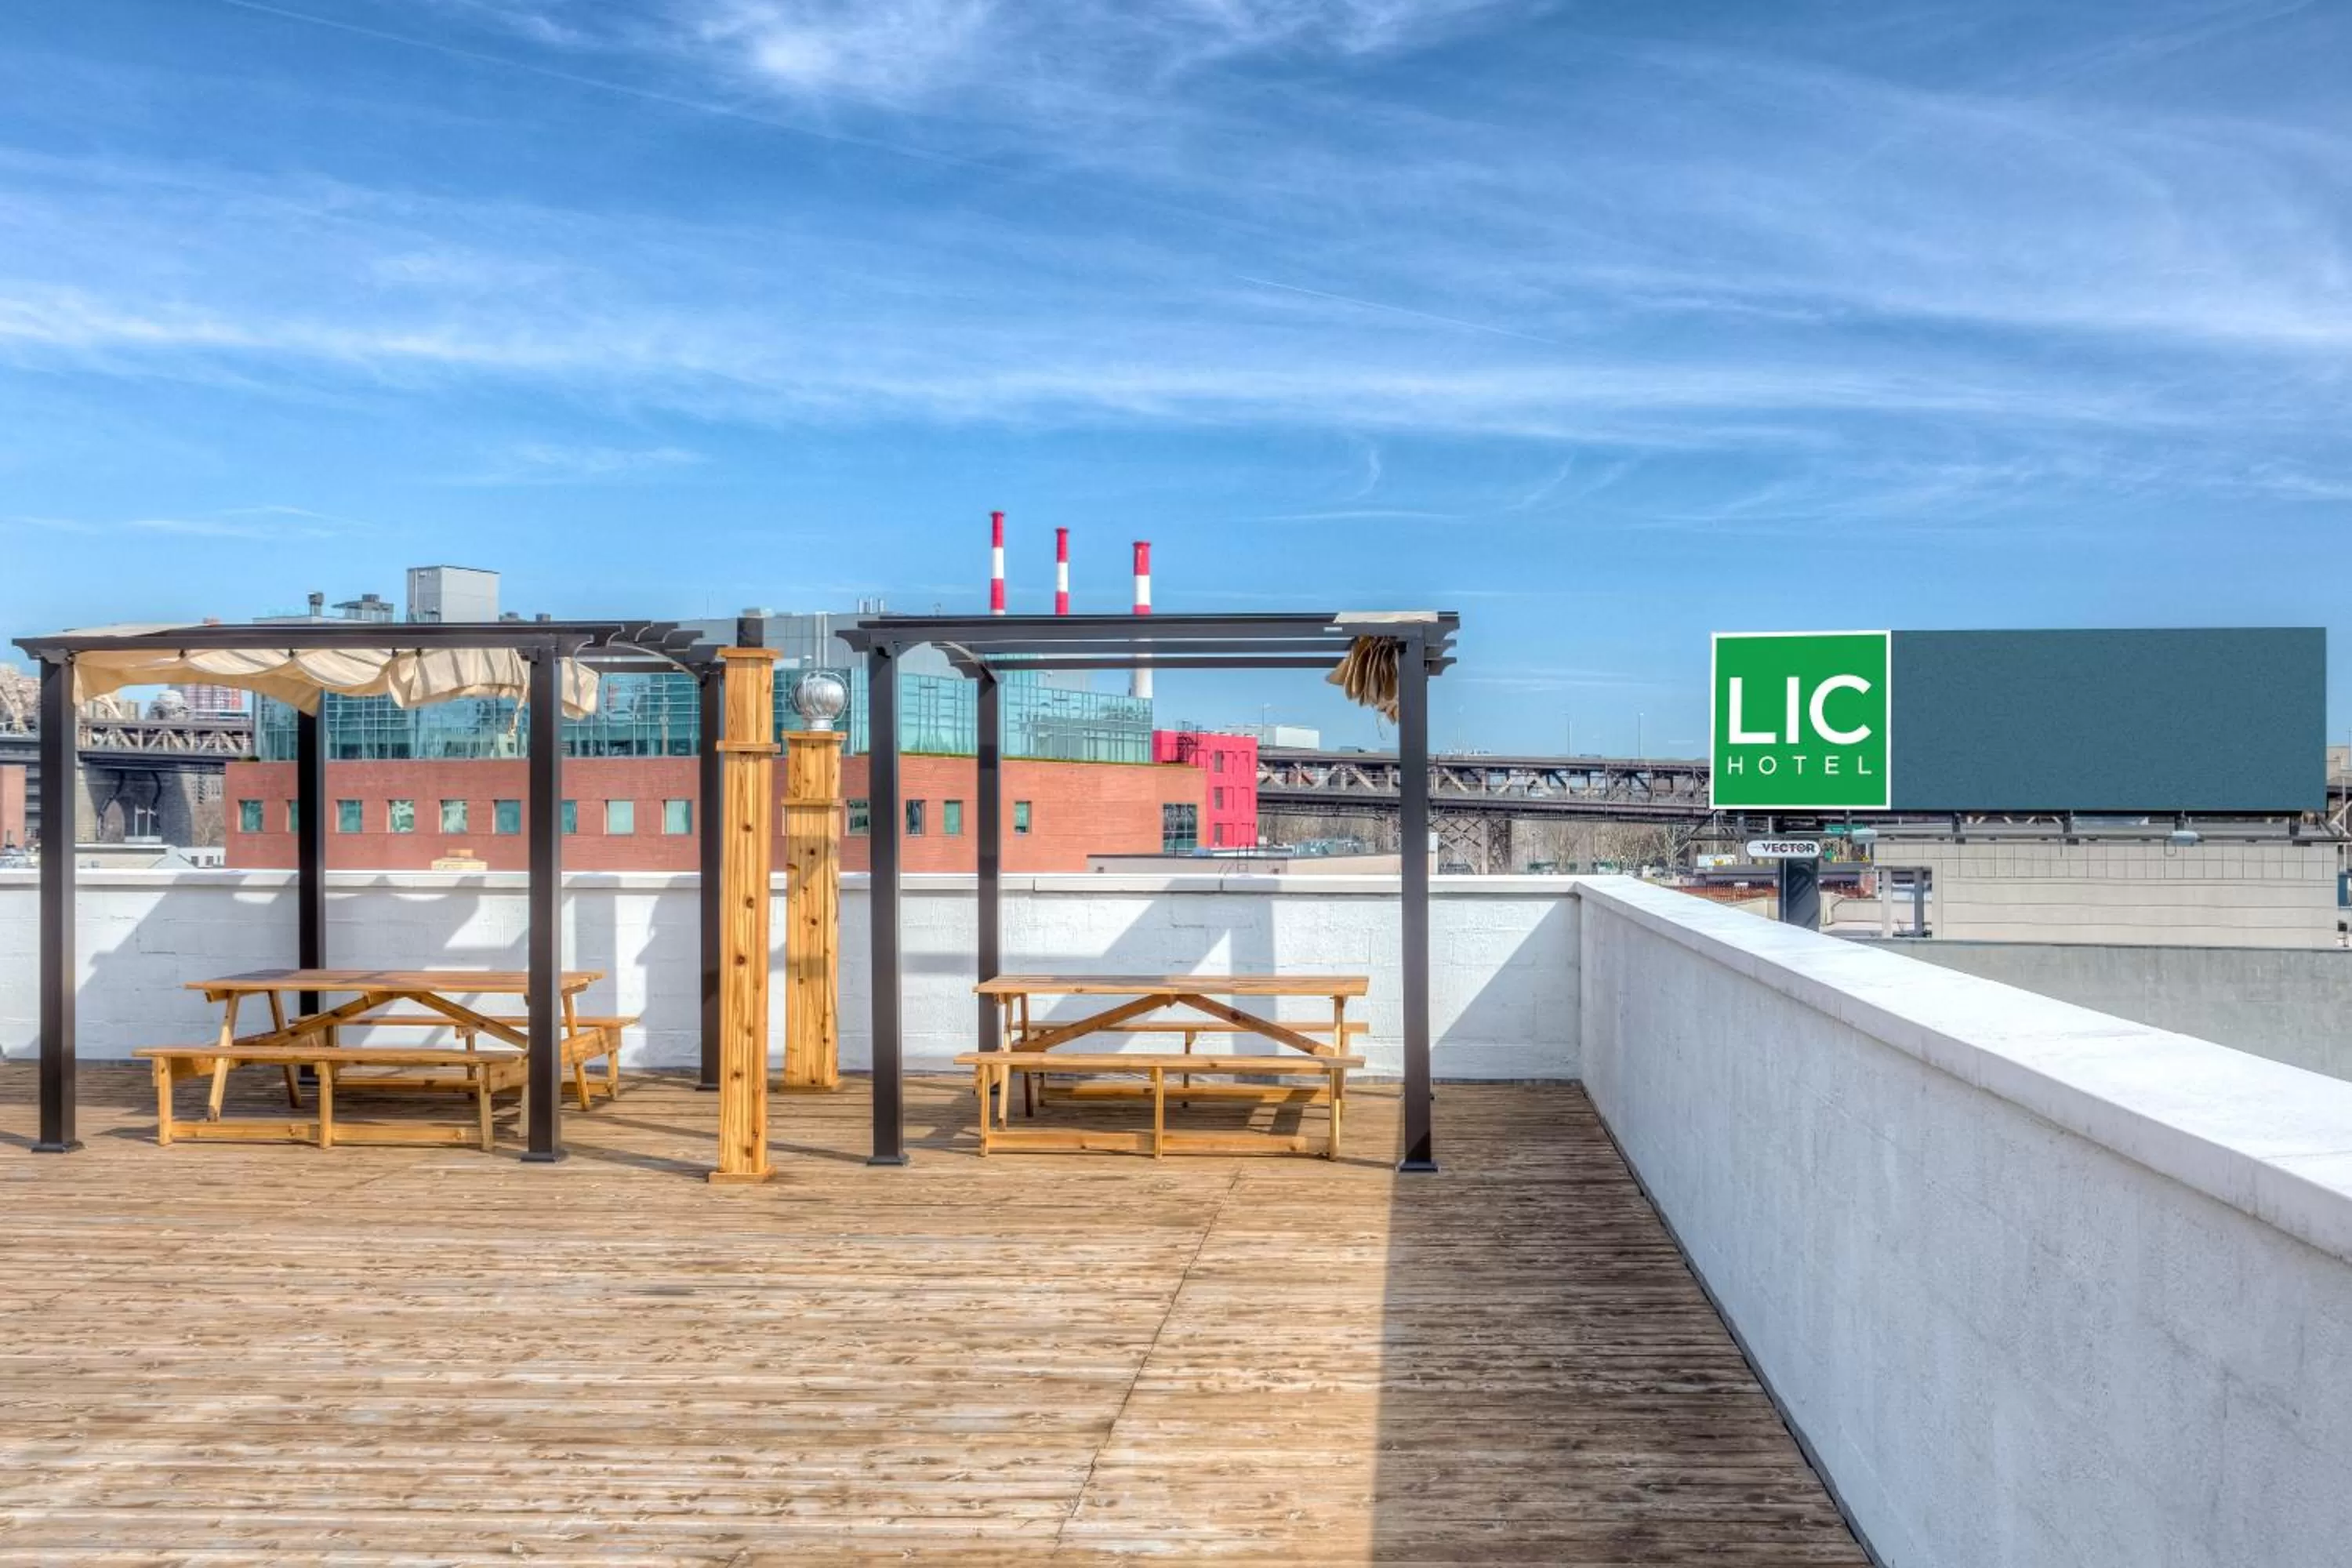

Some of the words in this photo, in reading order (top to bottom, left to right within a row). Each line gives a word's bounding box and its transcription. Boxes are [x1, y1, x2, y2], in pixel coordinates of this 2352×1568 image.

[1729, 674, 1871, 745] LIC
[1727, 755, 1872, 775] HOTEL
[1762, 843, 1815, 853] VECTOR
